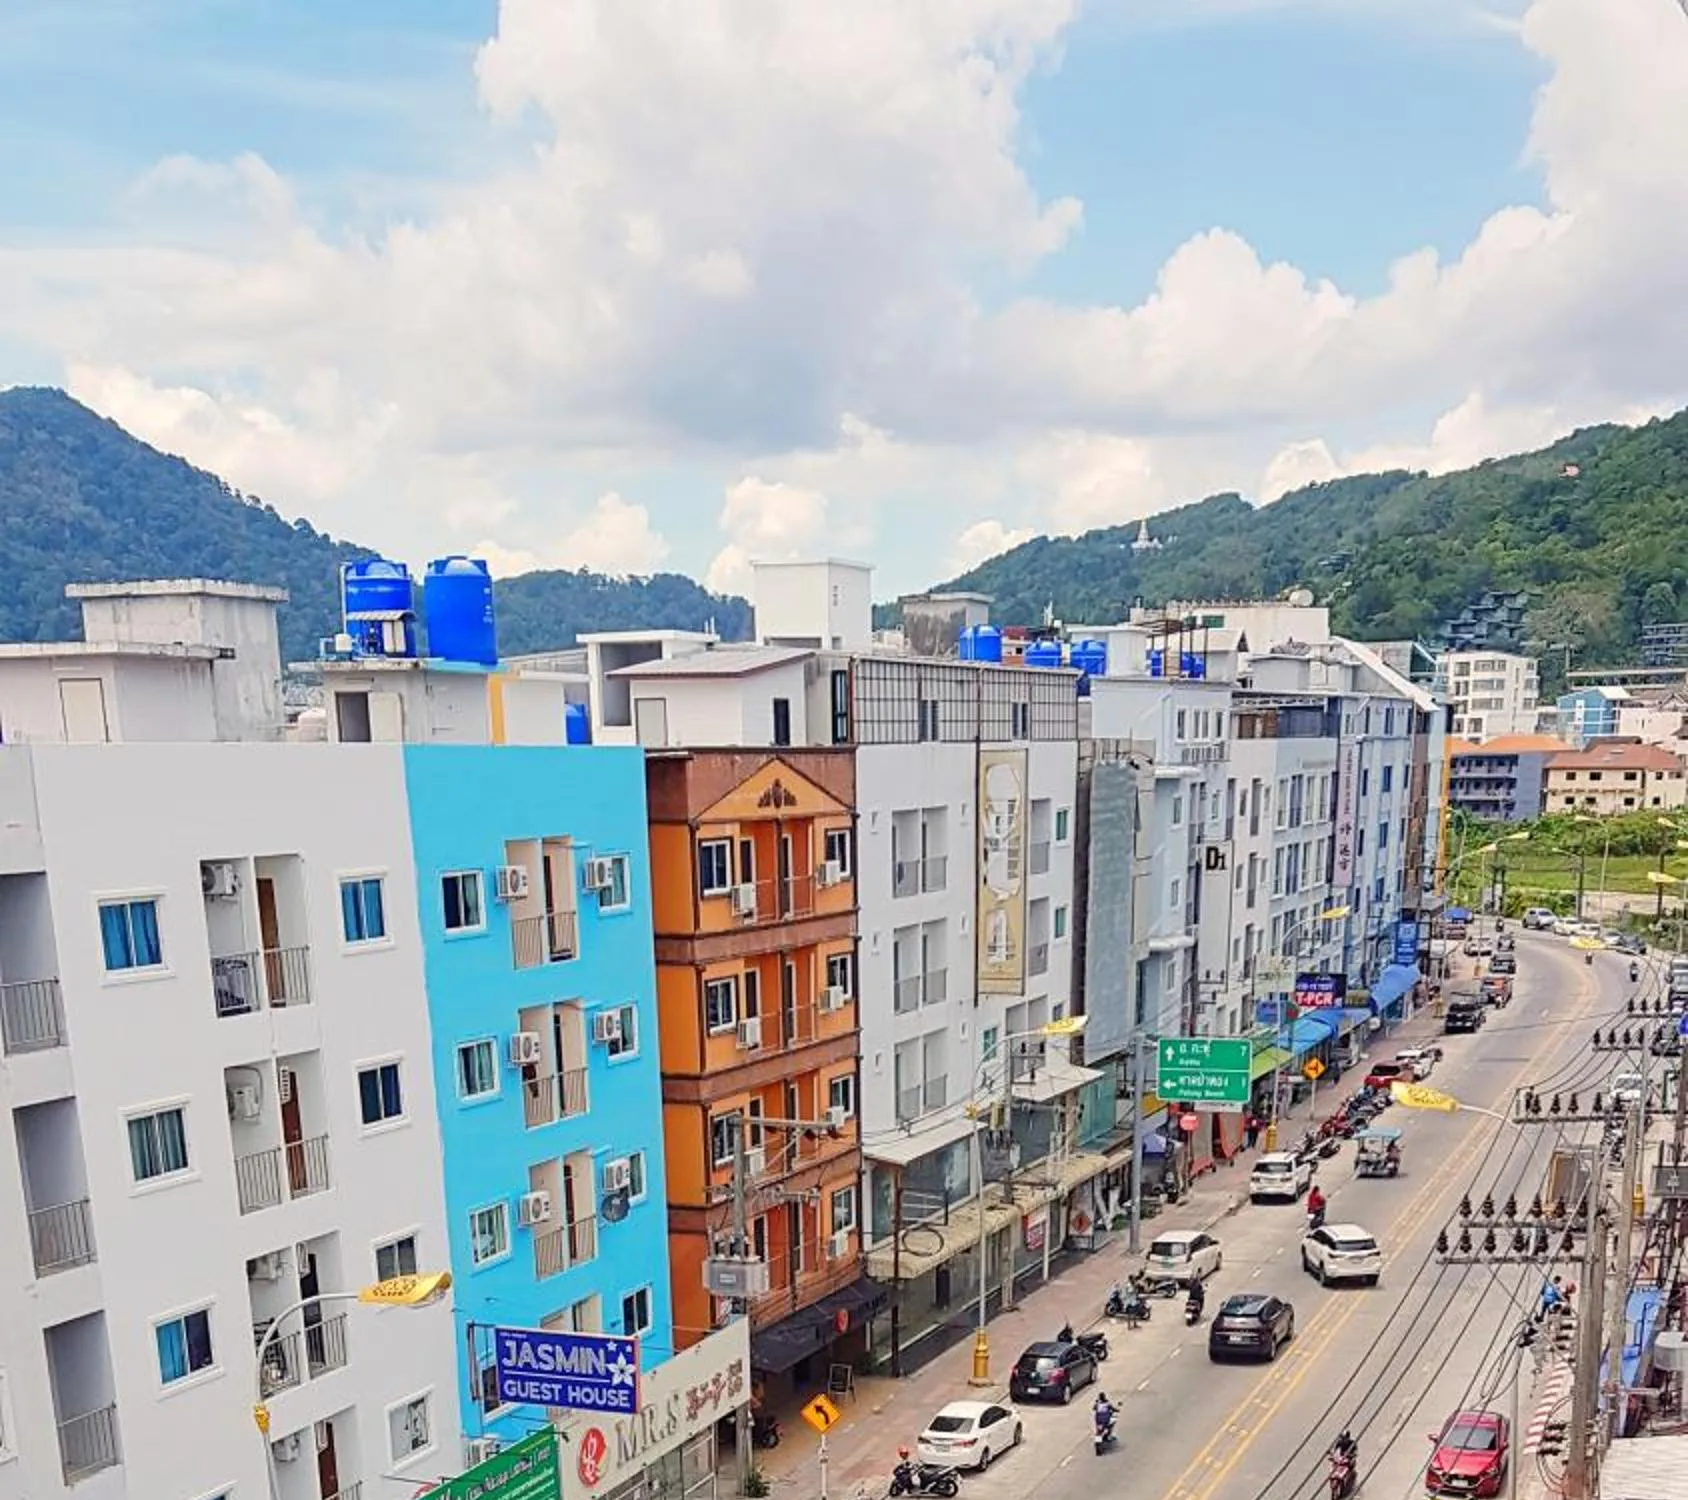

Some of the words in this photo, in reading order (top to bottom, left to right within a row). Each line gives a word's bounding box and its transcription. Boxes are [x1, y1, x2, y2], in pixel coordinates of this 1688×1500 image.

[502, 1340, 606, 1376] JASMIN
[503, 1380, 562, 1401] GUEST
[567, 1384, 630, 1408] HOUSE
